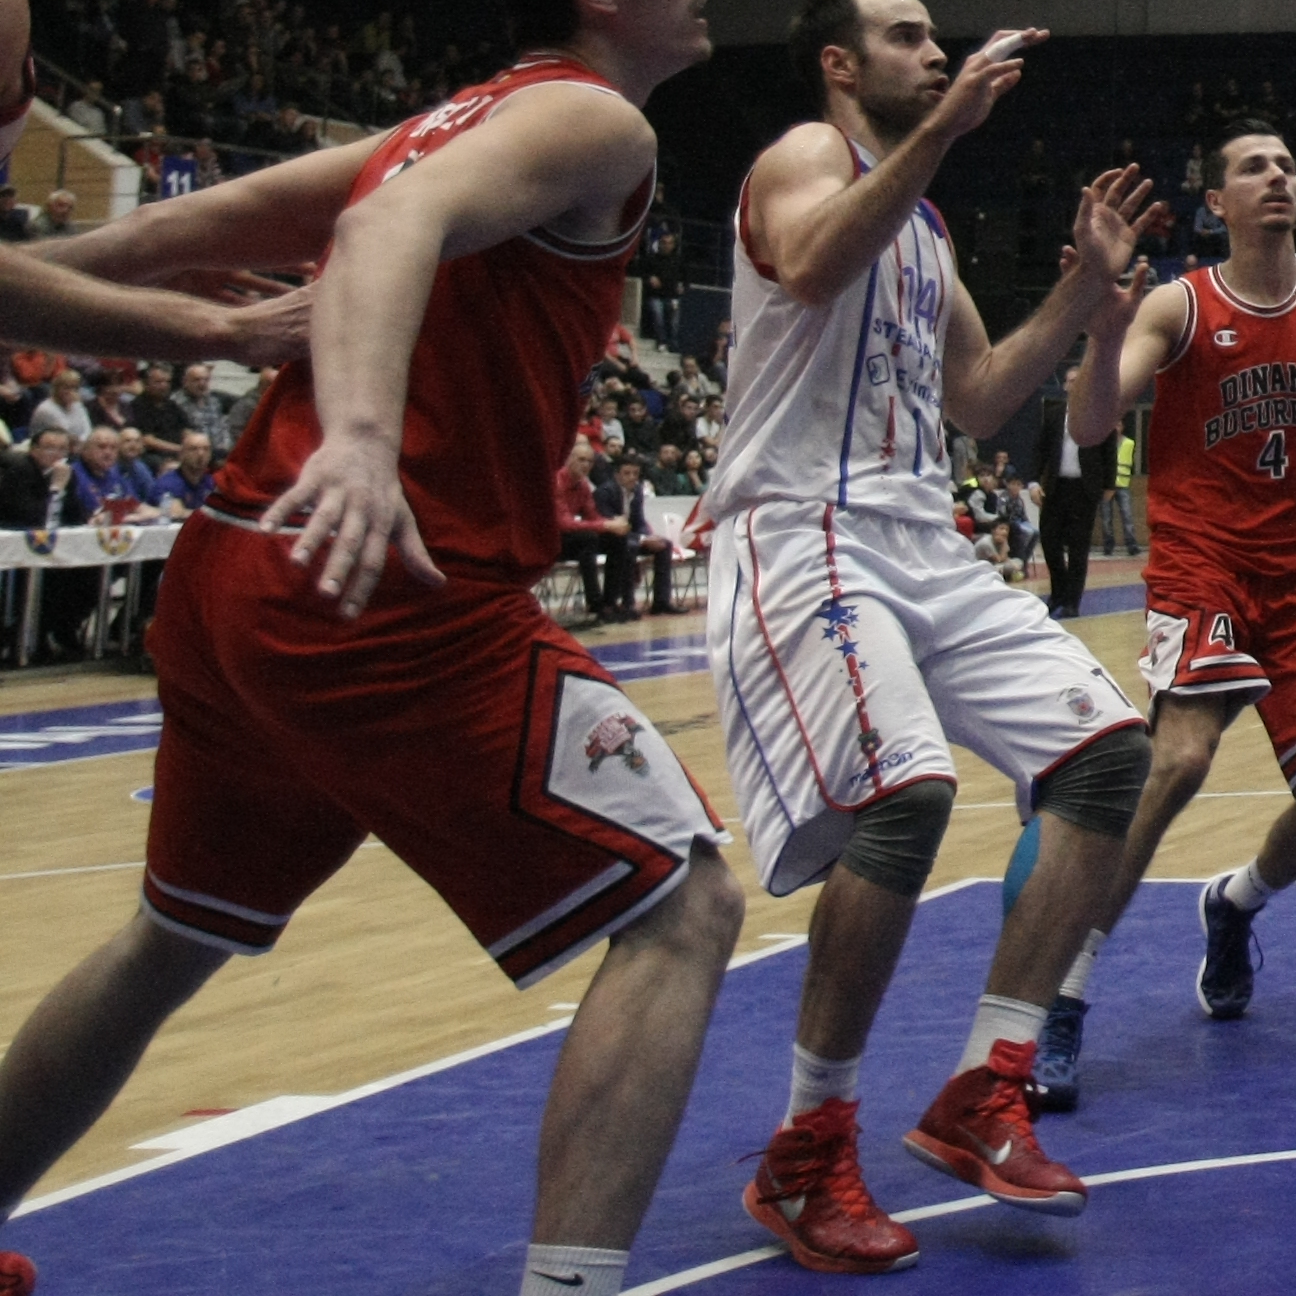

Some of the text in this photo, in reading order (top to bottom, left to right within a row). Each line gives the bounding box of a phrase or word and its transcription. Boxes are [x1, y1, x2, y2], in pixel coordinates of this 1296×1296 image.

[166, 170, 191, 196] 11
[902, 266, 937, 334] 14
[1257, 430, 1289, 479] 4
